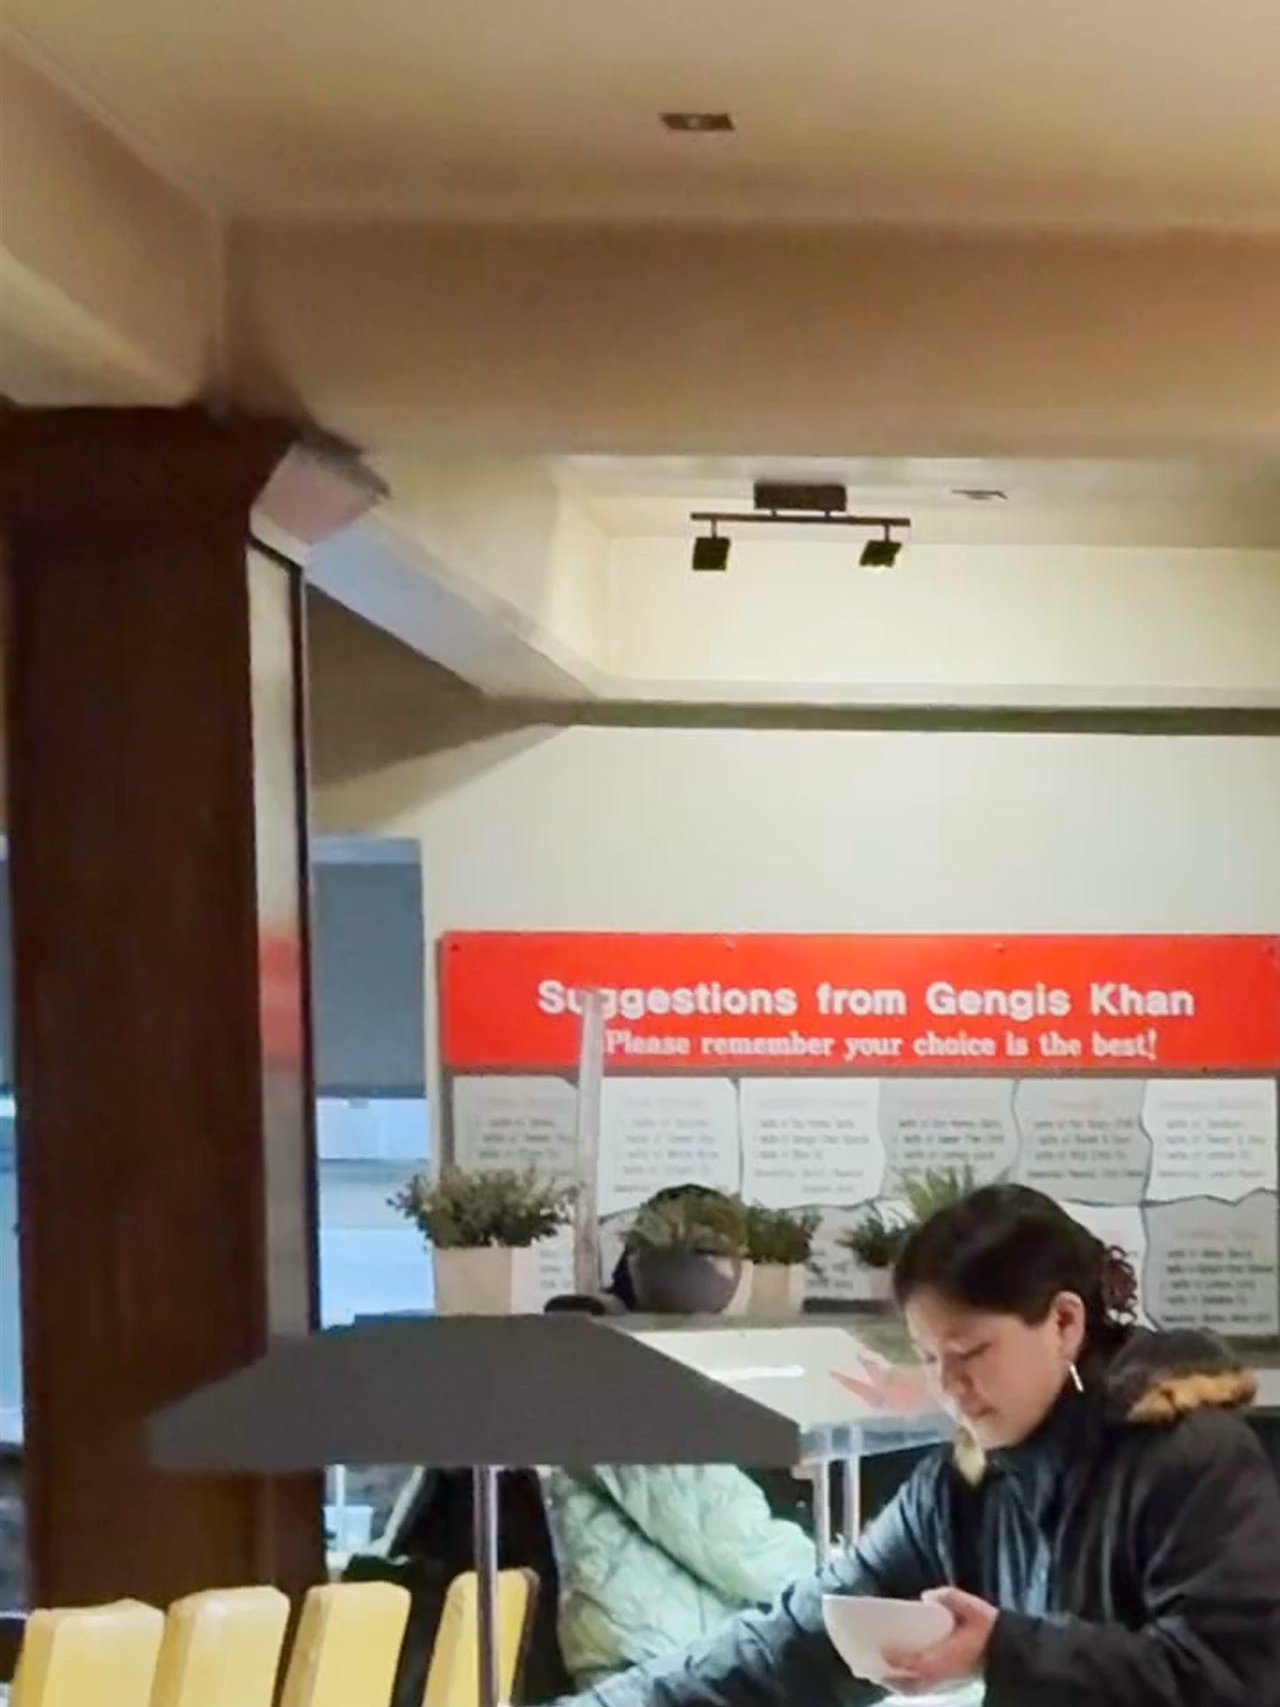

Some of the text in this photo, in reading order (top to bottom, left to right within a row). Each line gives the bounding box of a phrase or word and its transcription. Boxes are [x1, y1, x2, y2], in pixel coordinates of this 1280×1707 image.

[538, 980, 1194, 1022] Suggestions from Gengis Khan
[606, 1026, 1157, 1062] Please remember your choice is the best!
